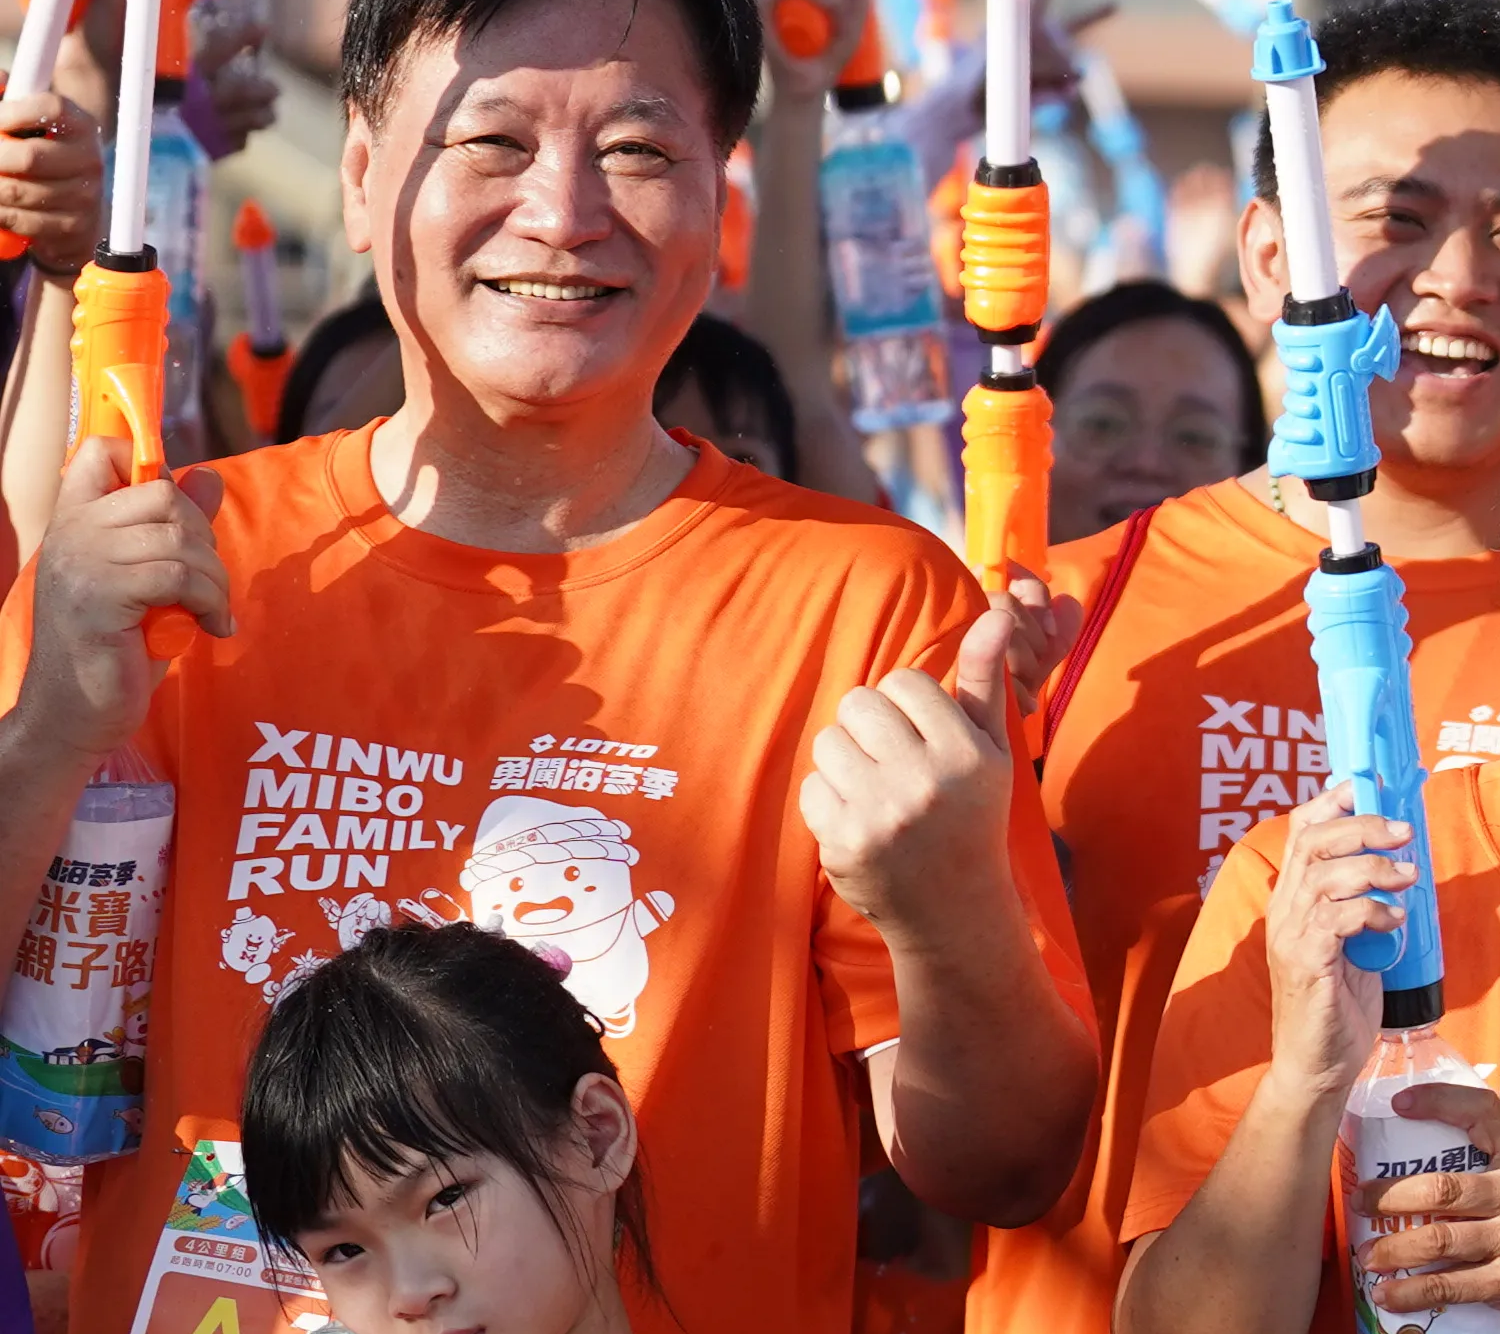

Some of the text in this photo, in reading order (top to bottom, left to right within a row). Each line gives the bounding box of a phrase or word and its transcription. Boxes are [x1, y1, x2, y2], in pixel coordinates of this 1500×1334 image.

[247, 721, 463, 786] XINWU
[559, 737, 658, 760] LOTTO
[243, 768, 424, 817] MIBO
[235, 812, 466, 855] FAMILY
[226, 854, 390, 902] RUN
[14, 939, 158, 991] 親子路
[185, 1239, 248, 1261] 4公里組
